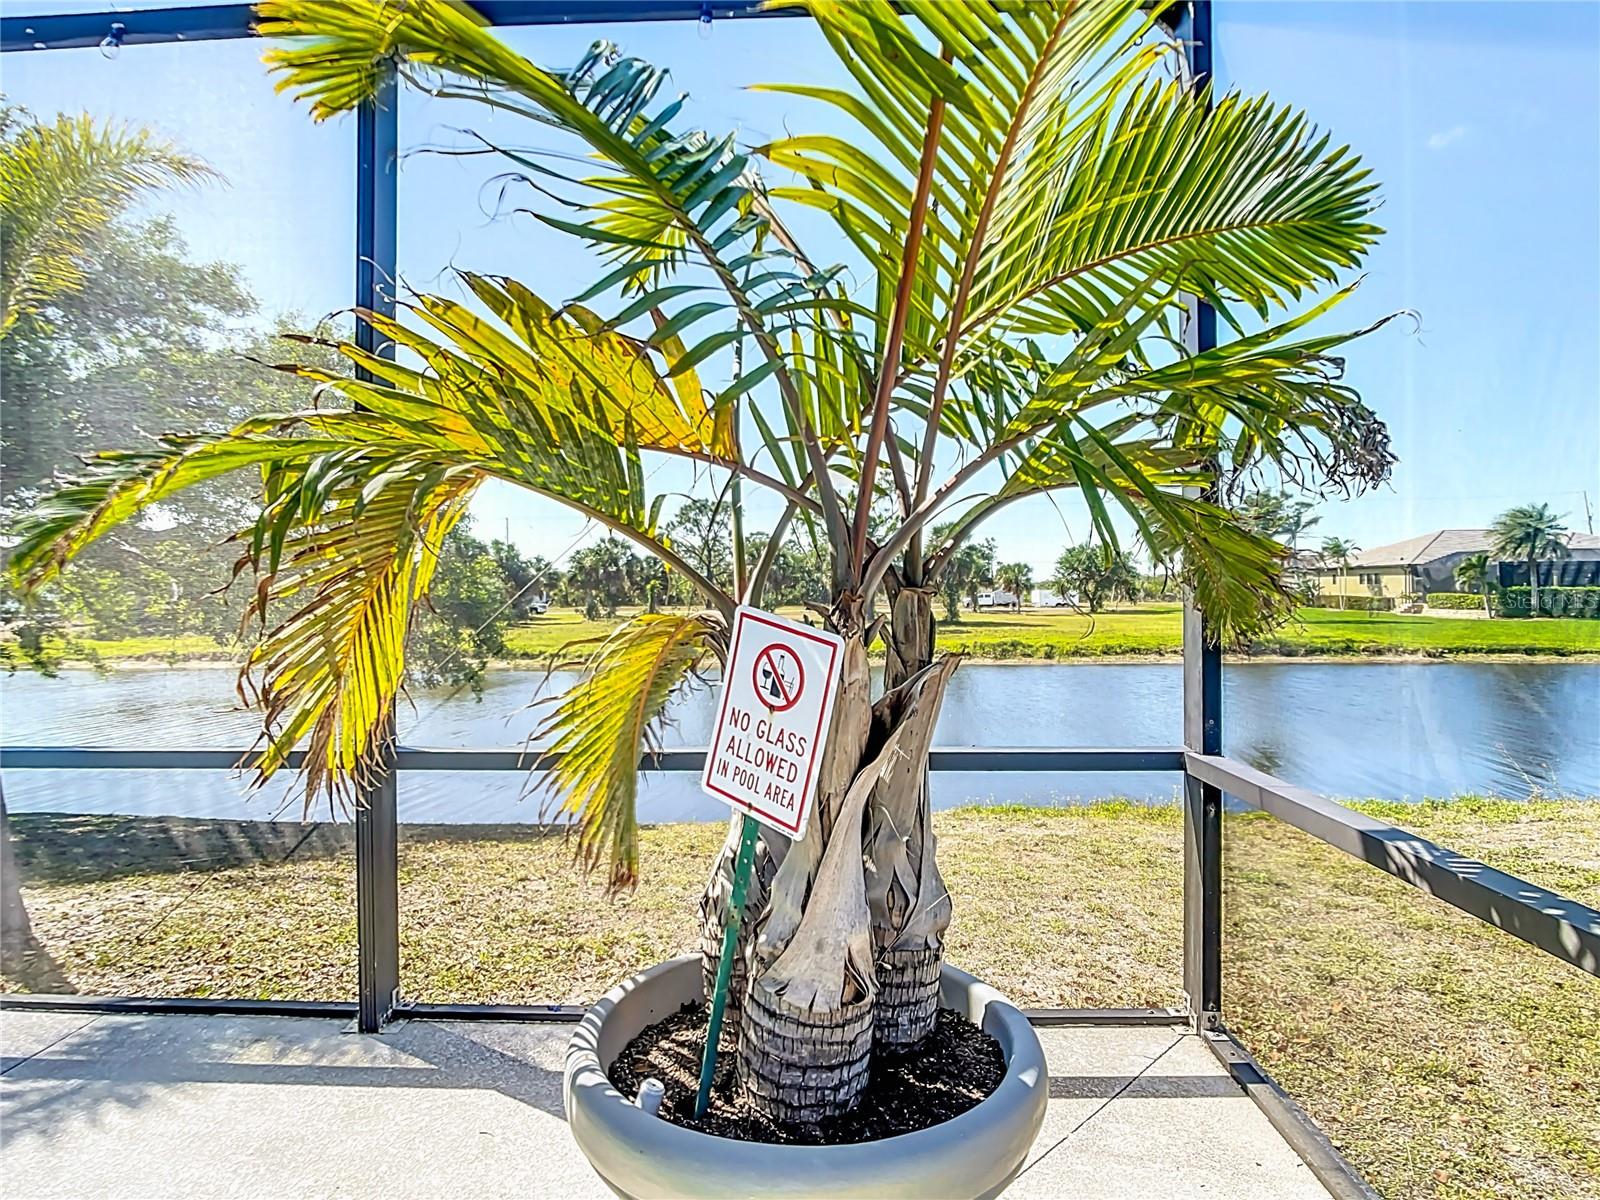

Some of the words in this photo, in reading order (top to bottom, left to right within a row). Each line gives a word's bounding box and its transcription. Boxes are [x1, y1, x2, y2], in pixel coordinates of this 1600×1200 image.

[729, 707, 750, 732] NO
[756, 719, 807, 757] GLASS
[726, 735, 798, 783] ALLOWED
[716, 758, 730, 779] IN
[732, 765, 760, 795] POOL
[764, 782, 794, 812] AREA
